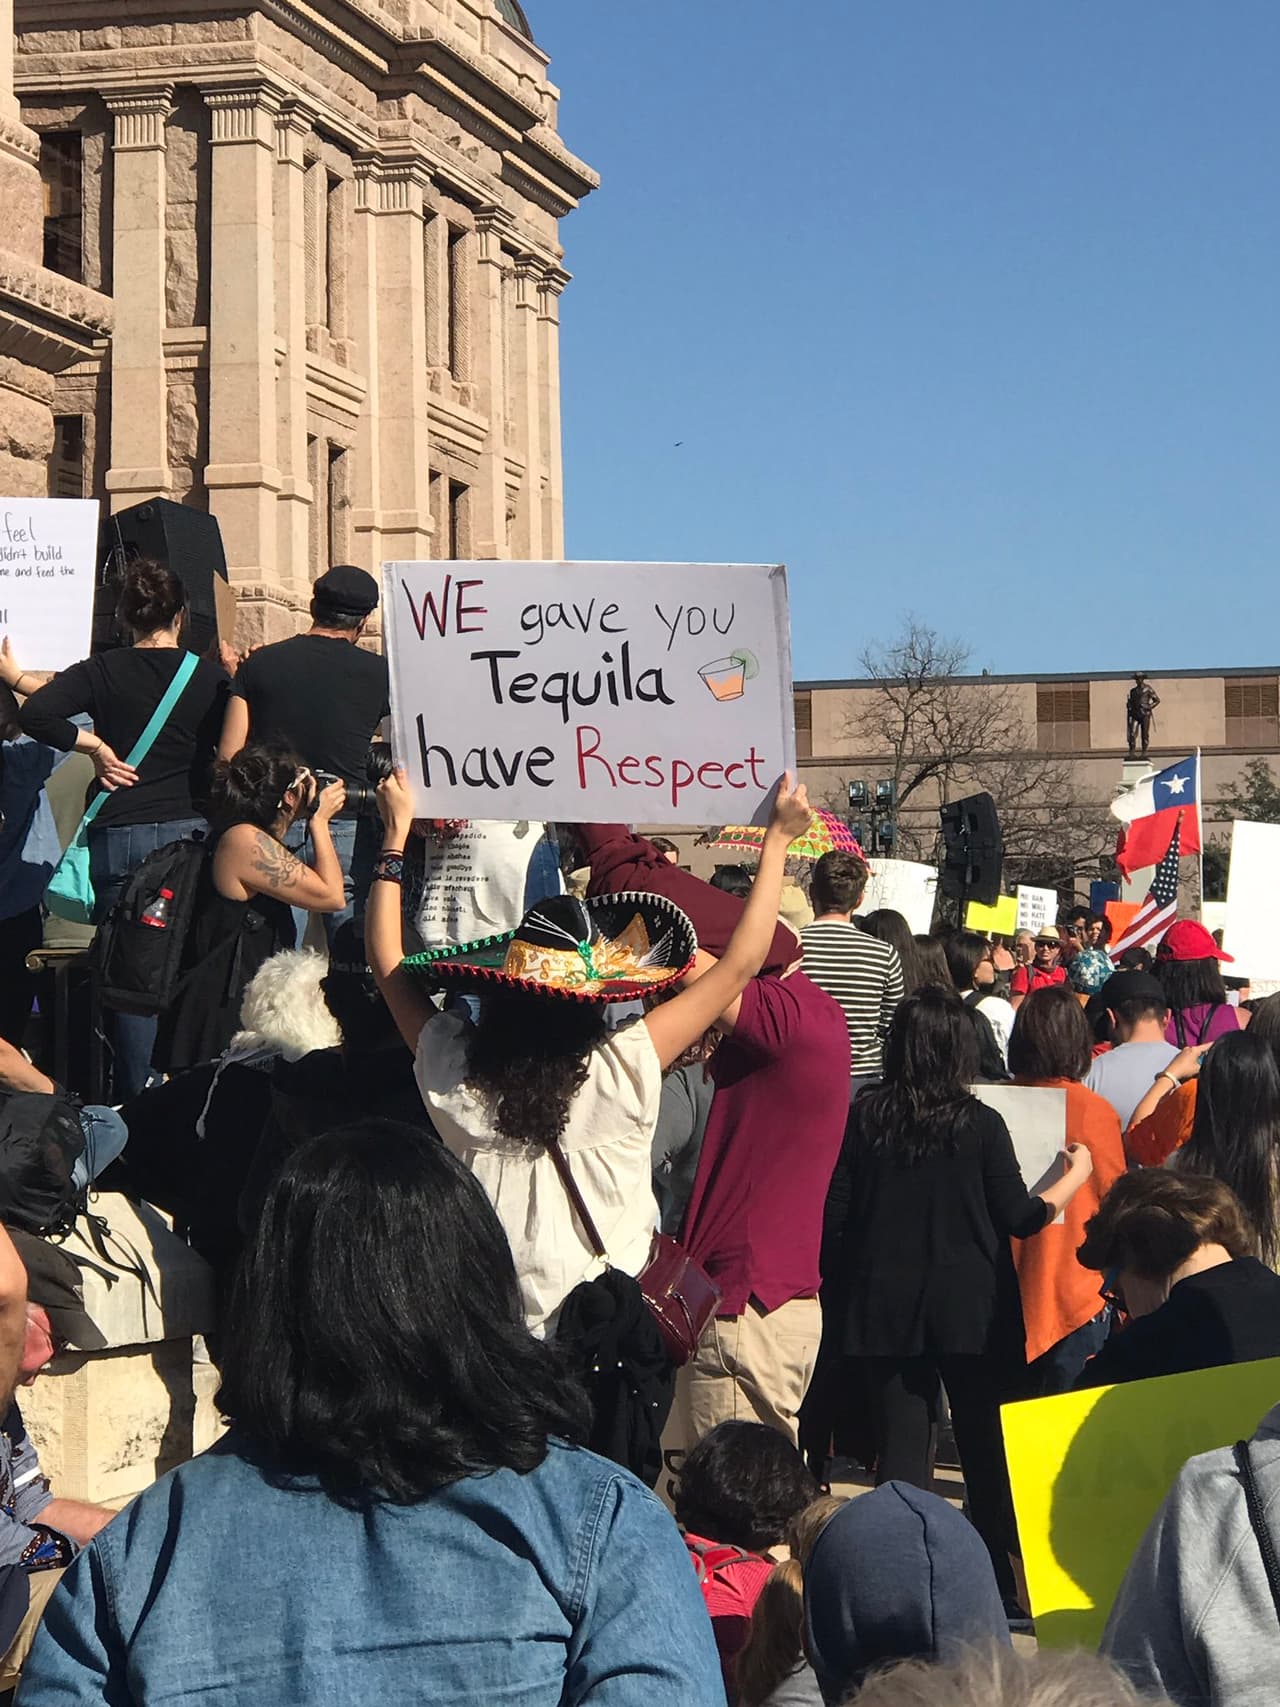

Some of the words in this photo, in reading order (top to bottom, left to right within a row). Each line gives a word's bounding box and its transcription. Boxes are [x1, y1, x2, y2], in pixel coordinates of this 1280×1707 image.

[2, 511, 37, 543] feel
[15, 566, 32, 577] and
[36, 565, 55, 578] feed
[60, 565, 75, 576] the
[34, 545, 63, 562] build
[401, 574, 488, 641] WE
[520, 598, 628, 645] gave
[470, 641, 675, 724] Tequila
[416, 713, 555, 789] have
[576, 725, 769, 807] Respect
